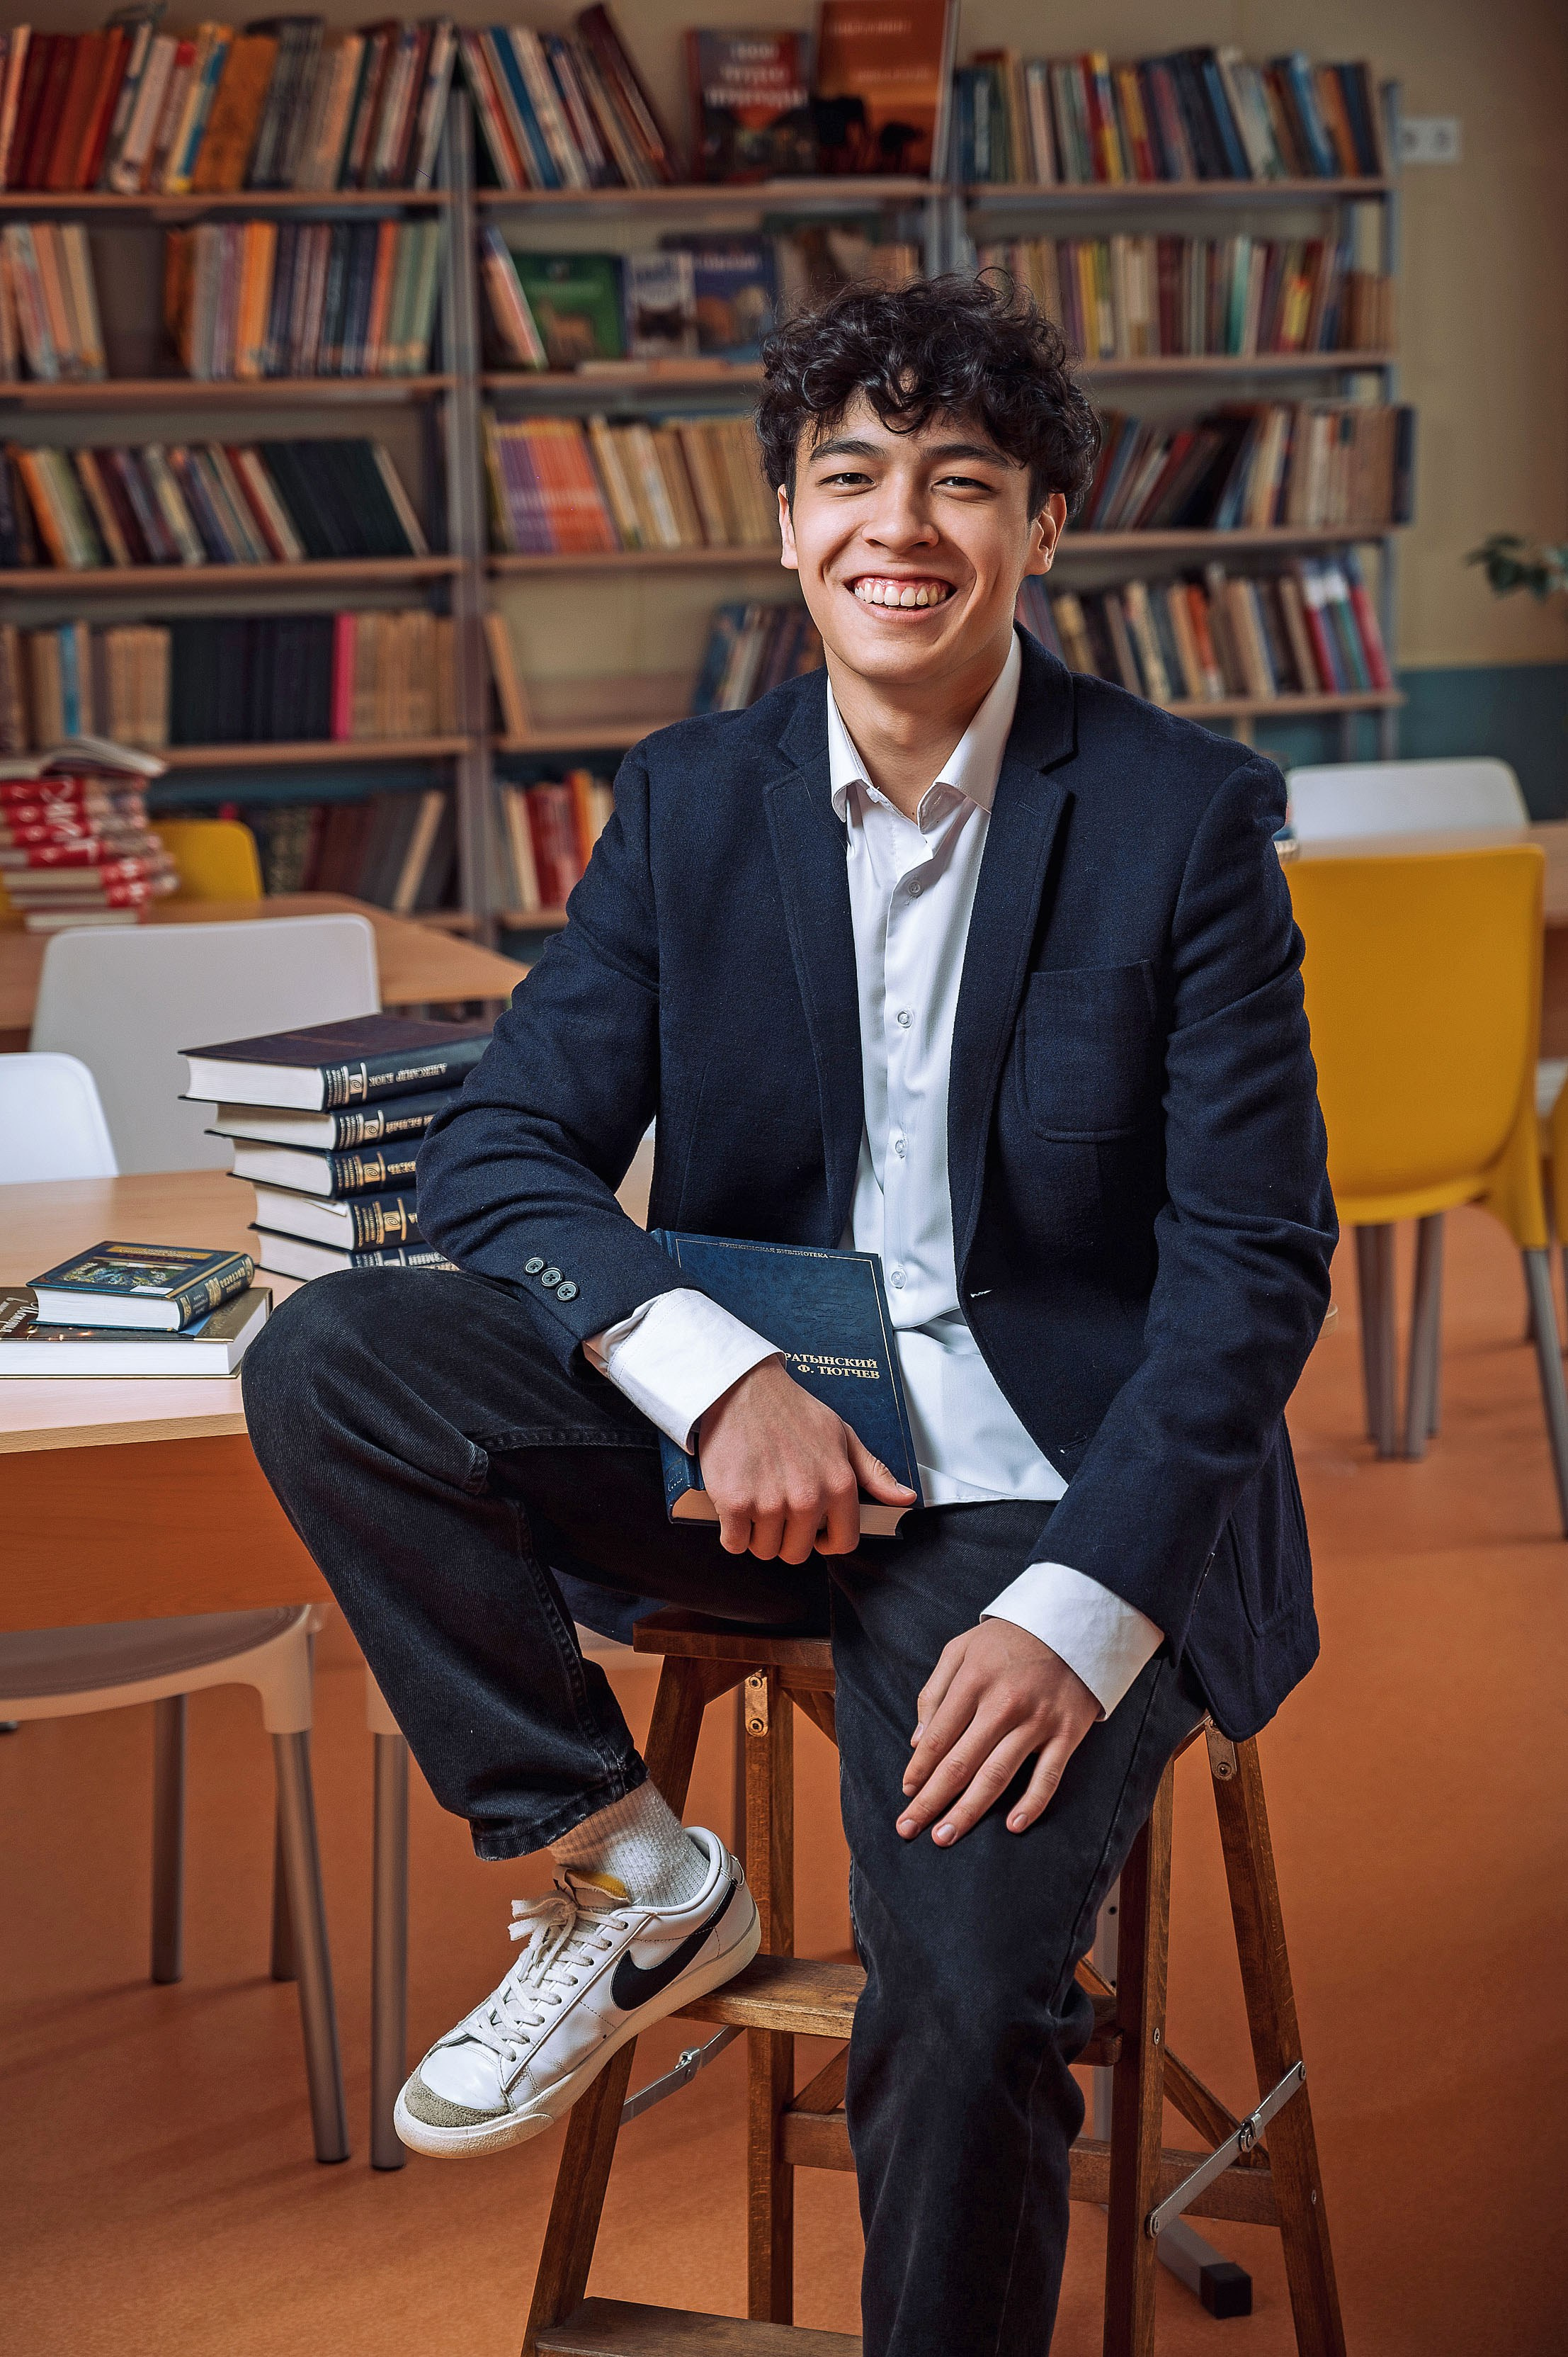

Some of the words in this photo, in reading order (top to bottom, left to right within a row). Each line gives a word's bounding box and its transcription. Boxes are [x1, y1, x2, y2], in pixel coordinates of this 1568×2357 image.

[368, 1072, 394, 1087] БЛОК
[776, 1248, 829, 1259] БИБЛИОТЕКА
[784, 1352, 878, 1369] РАТЫНСКИЙ
[797, 1364, 815, 1374] Ф.
[817, 1365, 880, 1379] ТЮТЧЕВ
